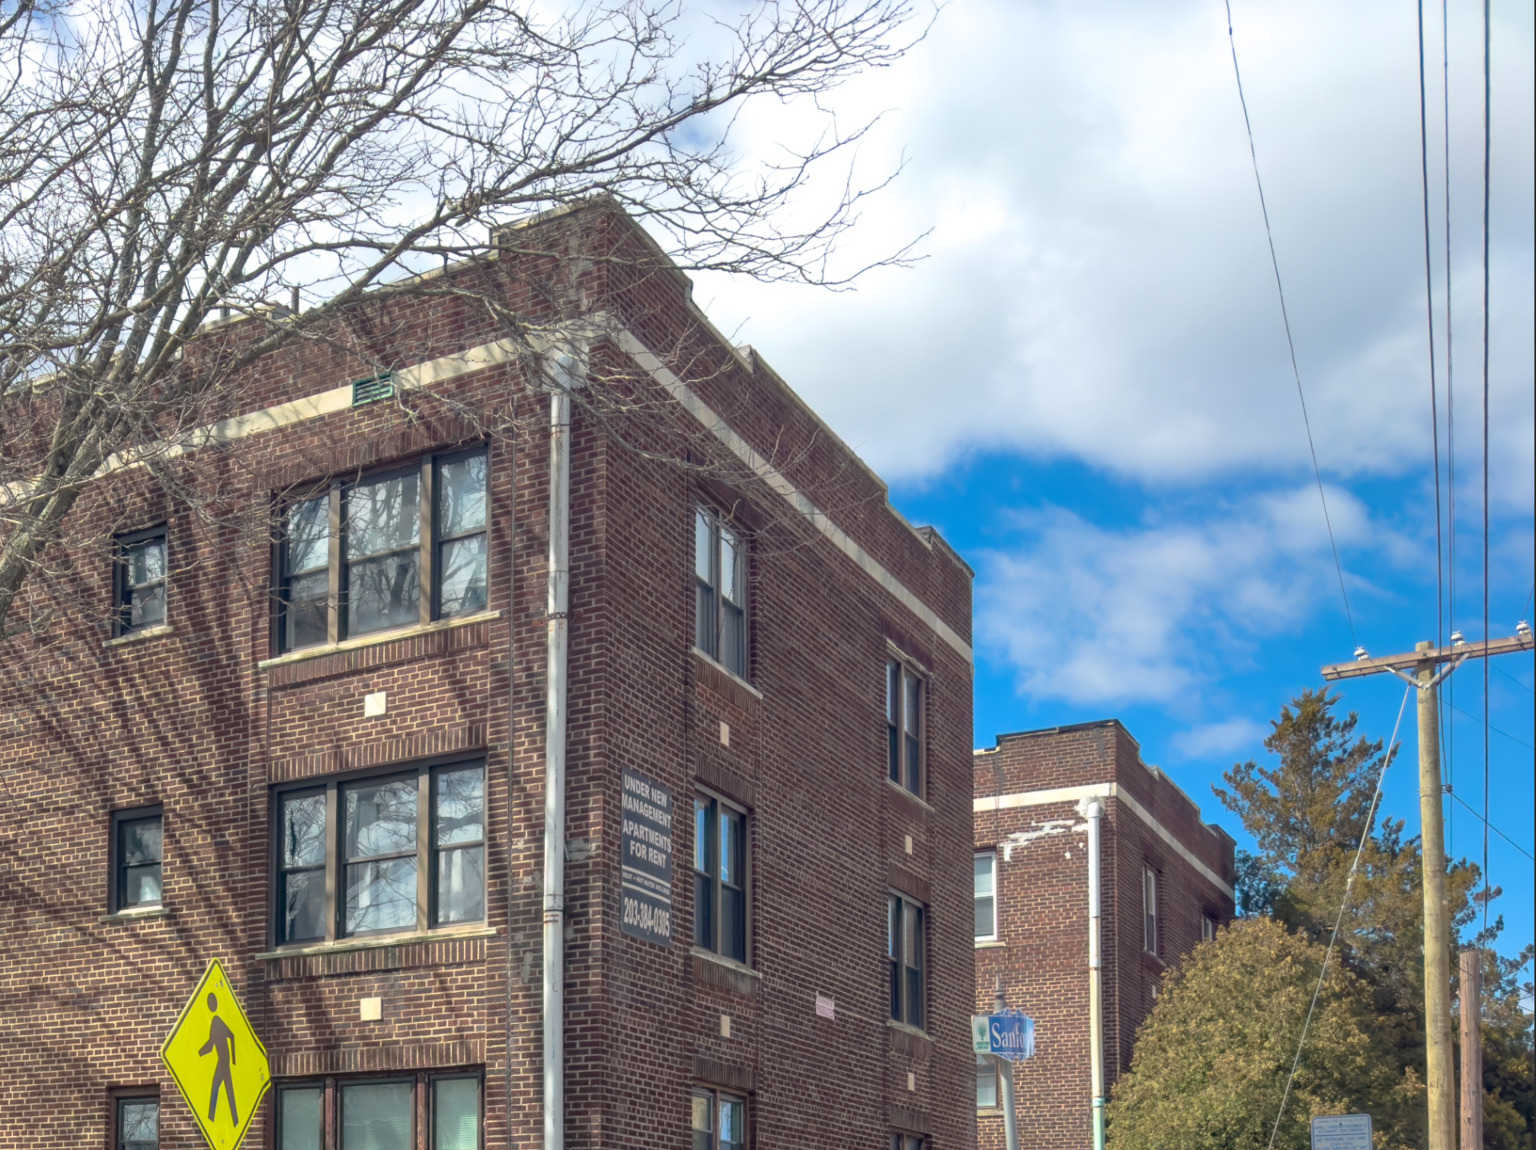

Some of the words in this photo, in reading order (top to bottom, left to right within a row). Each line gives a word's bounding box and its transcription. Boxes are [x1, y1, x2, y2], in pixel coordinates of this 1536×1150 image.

[624, 774, 650, 799] UNDER
[651, 787, 668, 808] NEW
[621, 792, 672, 829] MANAGEMENT
[622, 819, 672, 853] APARTMENTS
[630, 840, 647, 861] FOR
[648, 848, 667, 869] RENT
